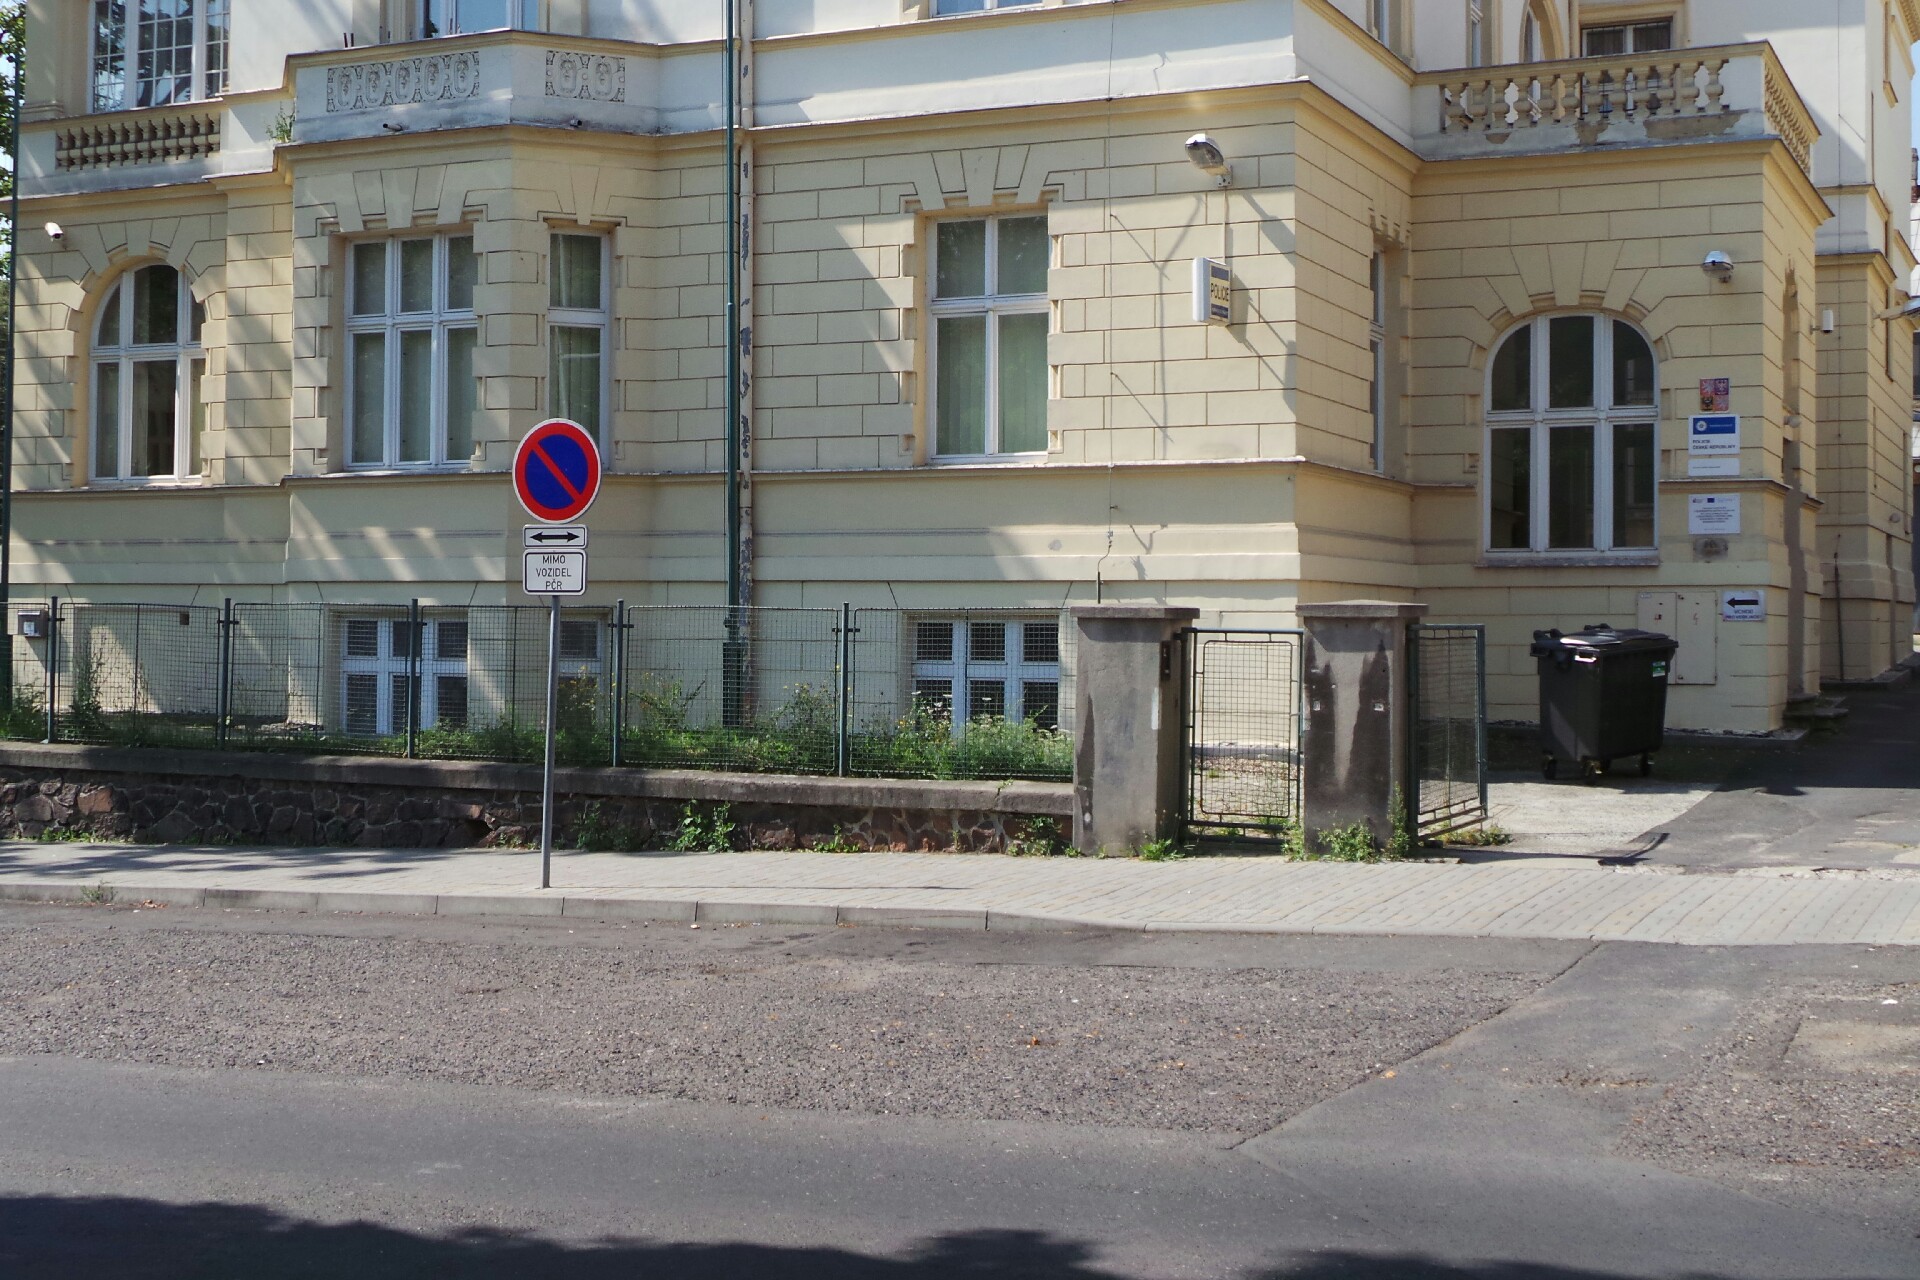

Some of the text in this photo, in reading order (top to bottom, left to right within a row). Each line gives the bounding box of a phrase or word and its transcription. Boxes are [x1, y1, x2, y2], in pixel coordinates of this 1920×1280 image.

[1211, 283, 1229, 302] POLICIE
[543, 555, 566, 564] MIMO
[536, 568, 572, 577] VOZIDEL
[546, 579, 563, 590] PČR
